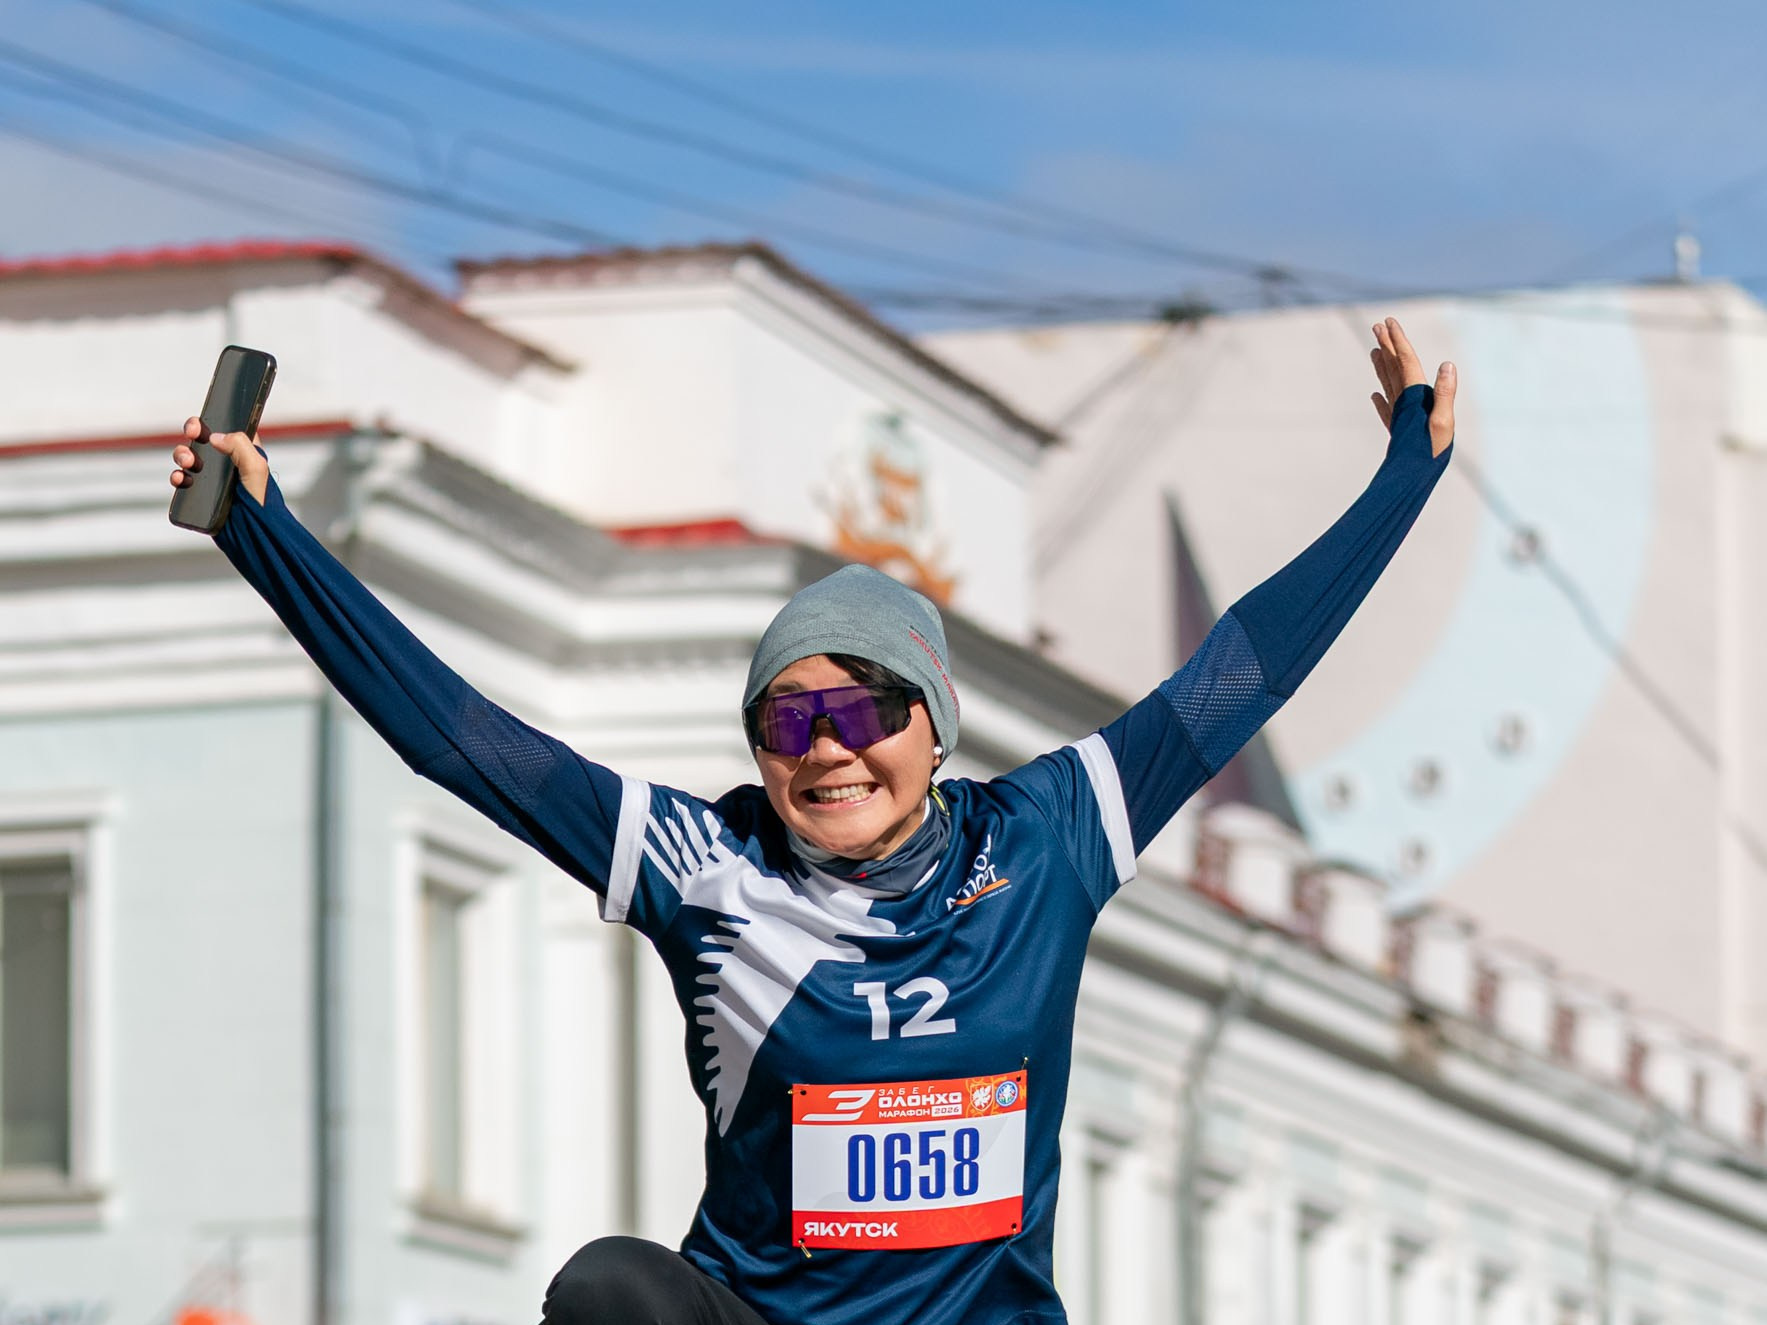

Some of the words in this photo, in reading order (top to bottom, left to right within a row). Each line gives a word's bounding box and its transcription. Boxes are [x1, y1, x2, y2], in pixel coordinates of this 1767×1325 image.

[853, 976, 957, 1041] 12
[878, 1085, 935, 1097] ЗАБЕГ
[878, 1092, 962, 1108] ОЛОНХО
[878, 1108, 931, 1118] МАРАФОН
[934, 1106, 960, 1114] 2026
[848, 1127, 980, 1203] 0658
[804, 1221, 898, 1238] ЯКУТСК
